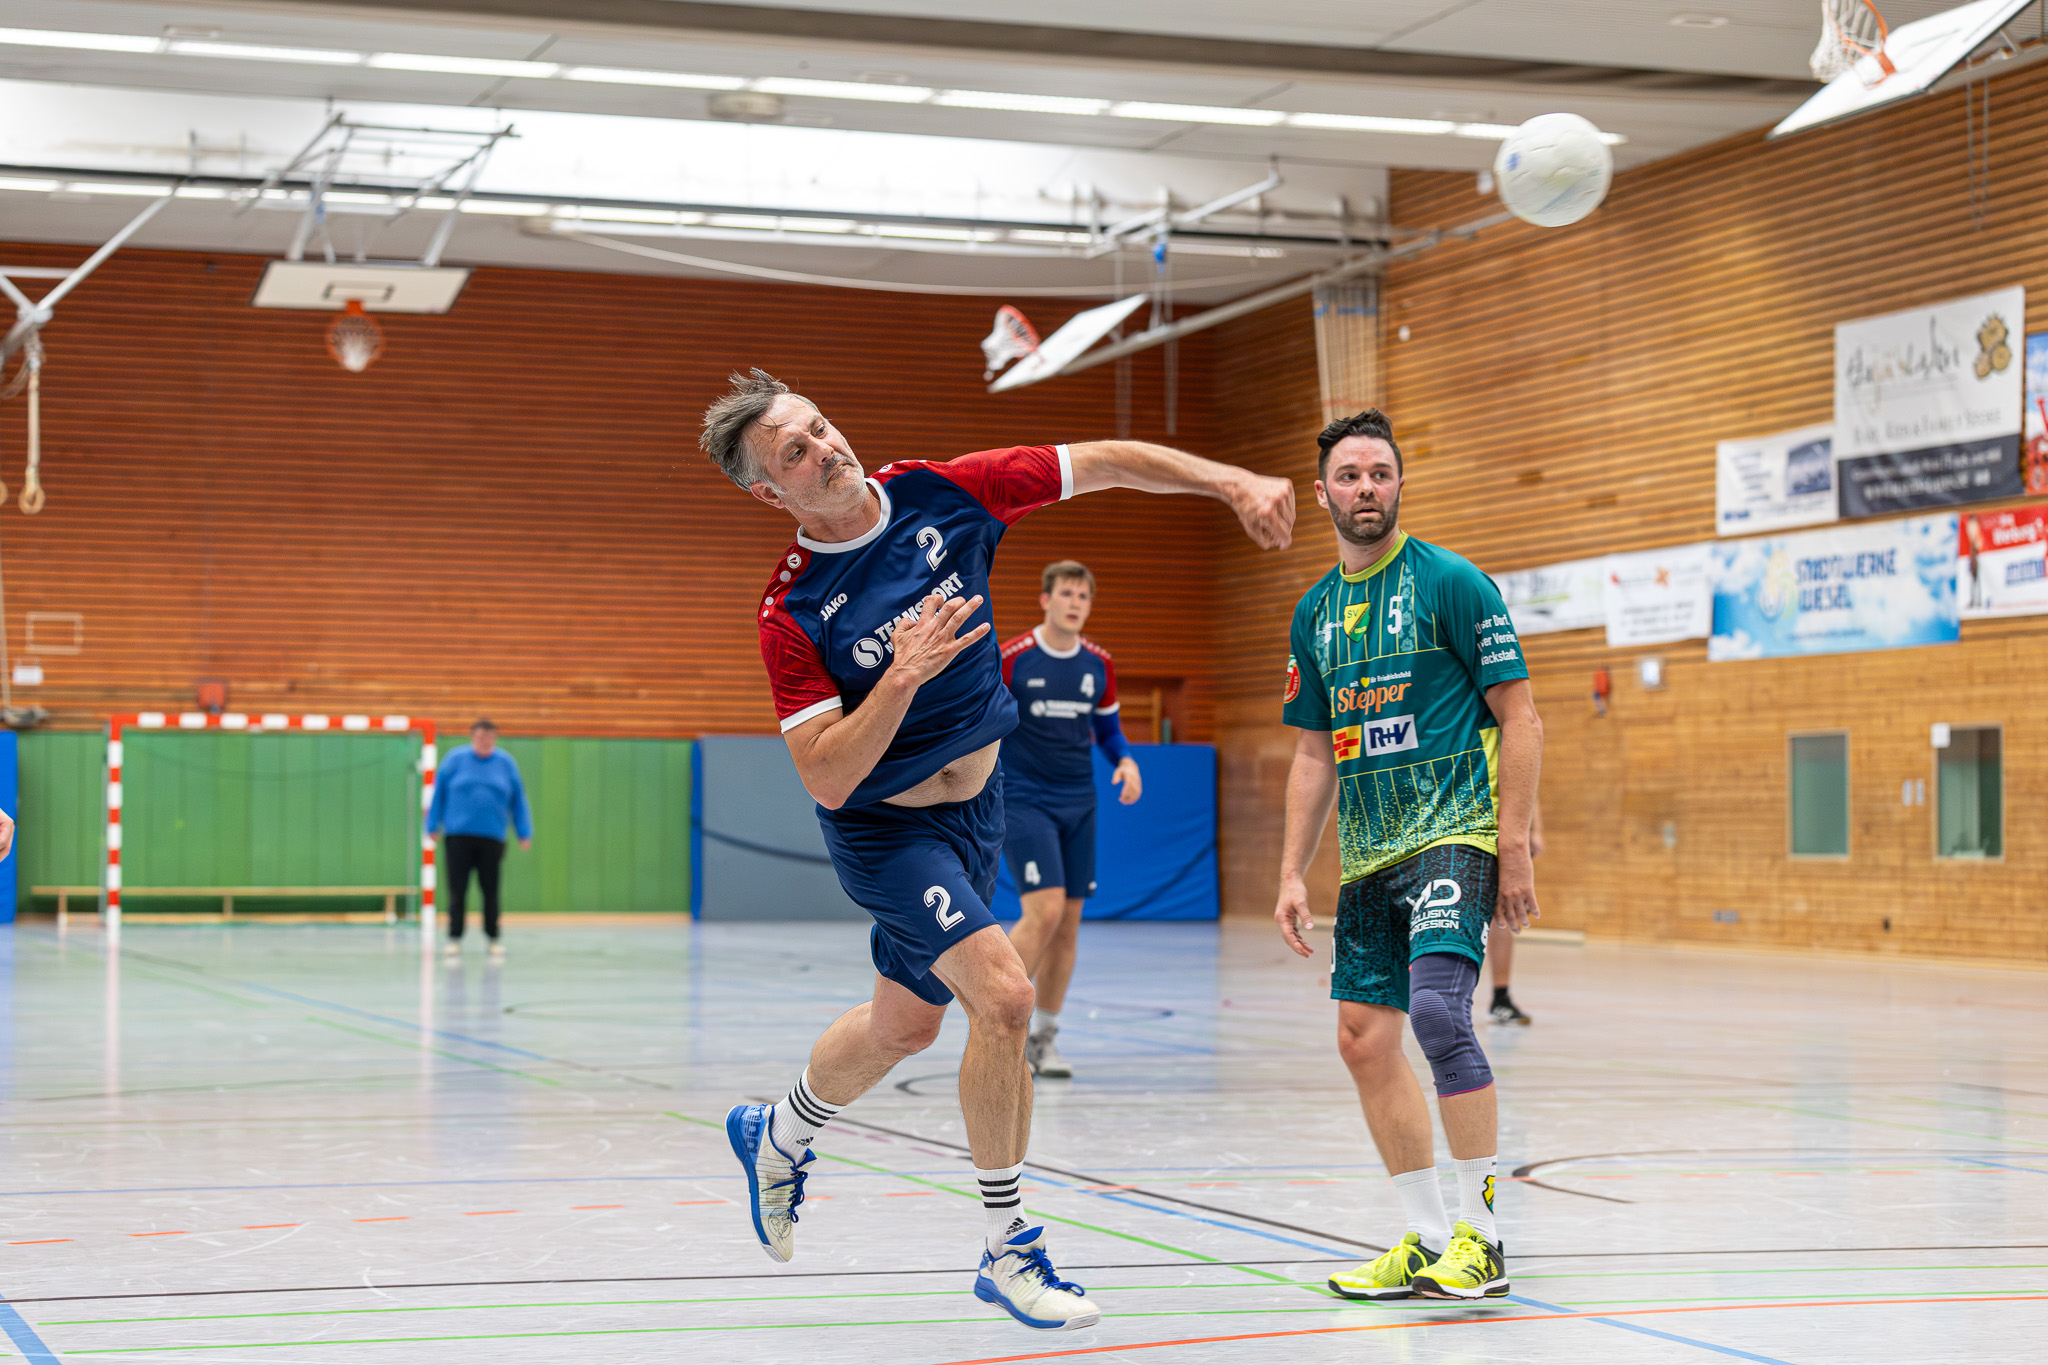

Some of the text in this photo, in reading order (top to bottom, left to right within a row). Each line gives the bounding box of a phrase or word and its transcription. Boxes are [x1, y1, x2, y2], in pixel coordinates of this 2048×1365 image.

[916, 526, 948, 571] 2
[820, 592, 848, 621] JAKO
[874, 571, 964, 642] TEAMSORT
[1346, 609, 1359, 619] SV
[1387, 596, 1403, 634] 5
[1080, 673, 1095, 698] 4
[1337, 682, 1412, 716] Stepper
[1369, 721, 1412, 749] R+V
[1024, 860, 1041, 885] 4
[923, 885, 966, 932] 2
